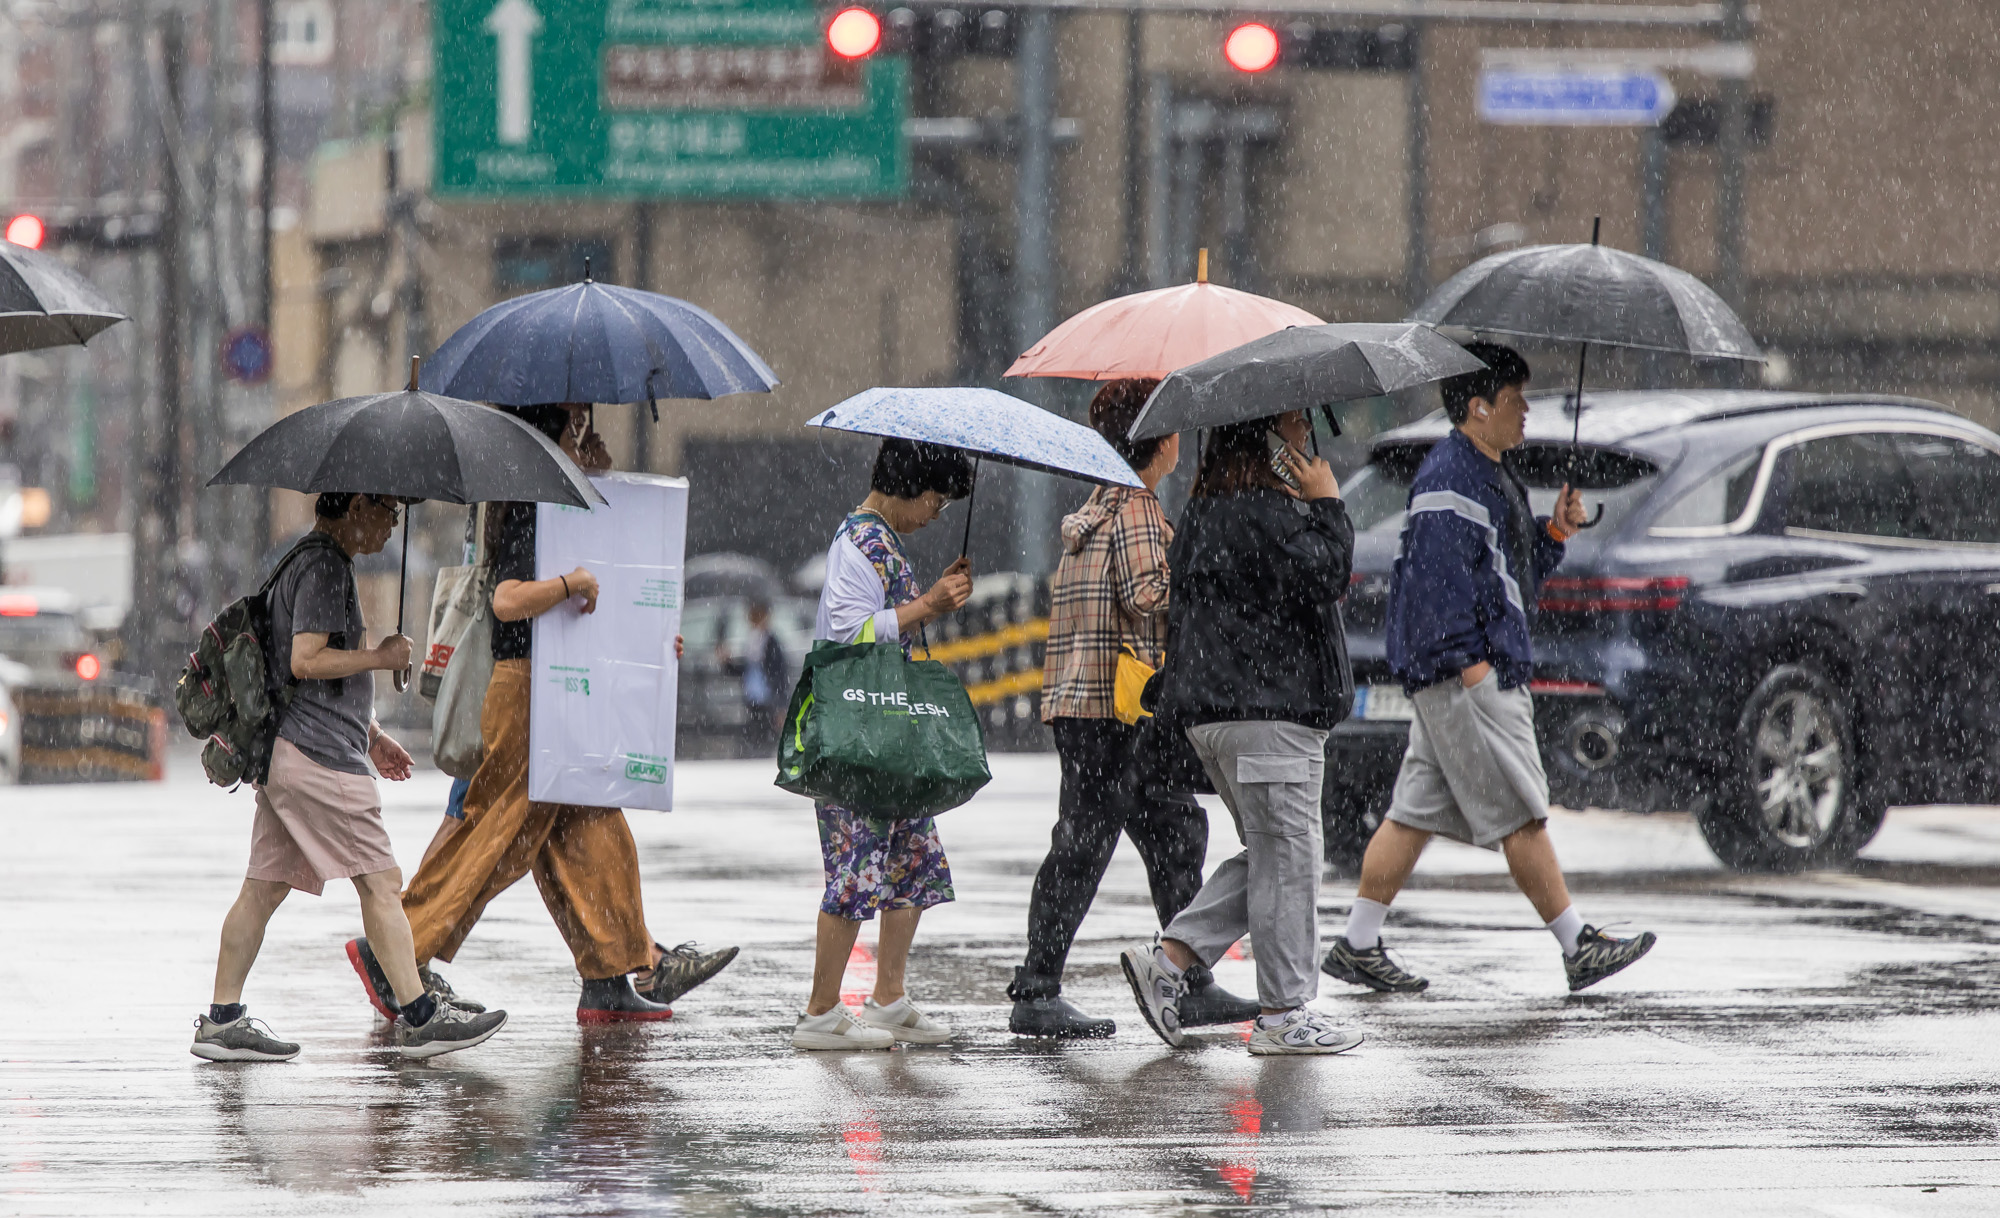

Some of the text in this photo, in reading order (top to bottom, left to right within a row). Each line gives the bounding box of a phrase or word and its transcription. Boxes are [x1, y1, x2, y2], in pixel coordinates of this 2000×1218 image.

[842, 688, 866, 703] GS
[867, 691, 909, 706] THE
[1293, 1027, 1310, 1041] N
